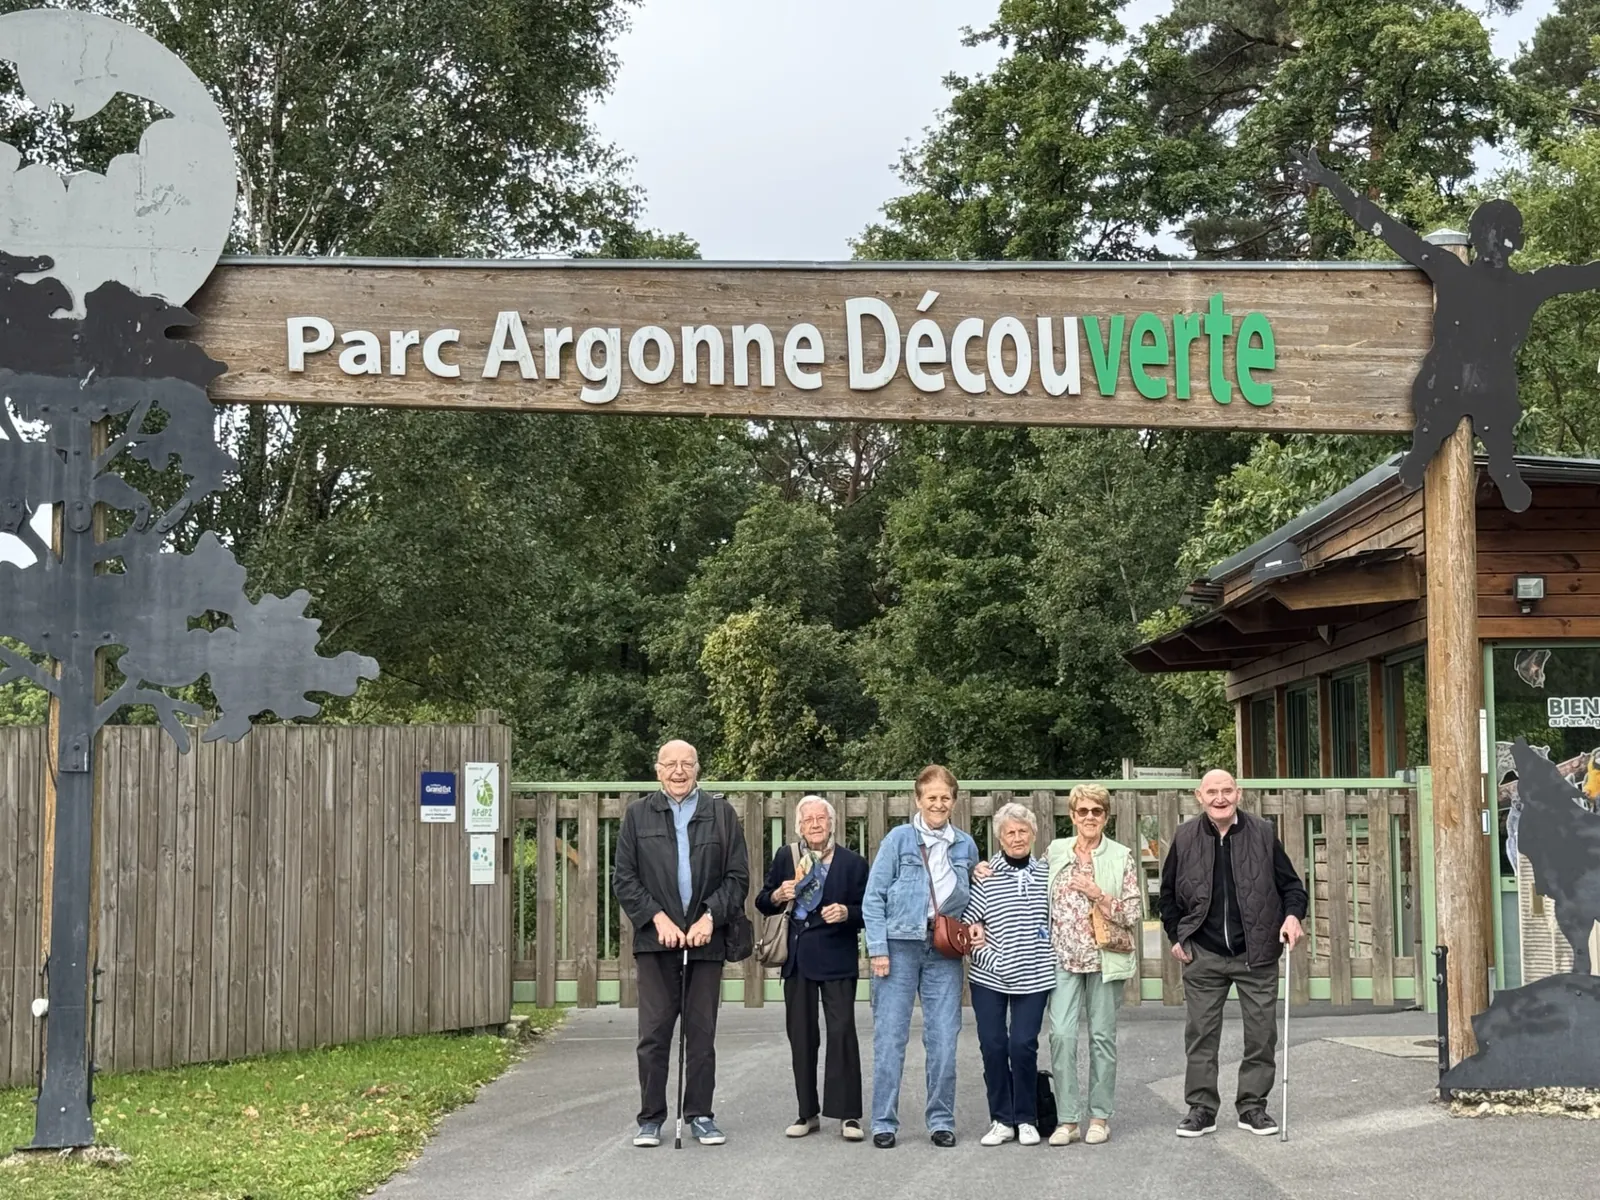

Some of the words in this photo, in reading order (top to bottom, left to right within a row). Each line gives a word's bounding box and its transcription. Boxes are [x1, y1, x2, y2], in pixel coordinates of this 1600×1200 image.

[286, 316, 461, 378] Parc
[481, 311, 825, 404] Argonne
[845, 289, 1276, 406] Découverte
[1549, 698, 1600, 716] BIEN
[1562, 717, 1583, 726] Parc
